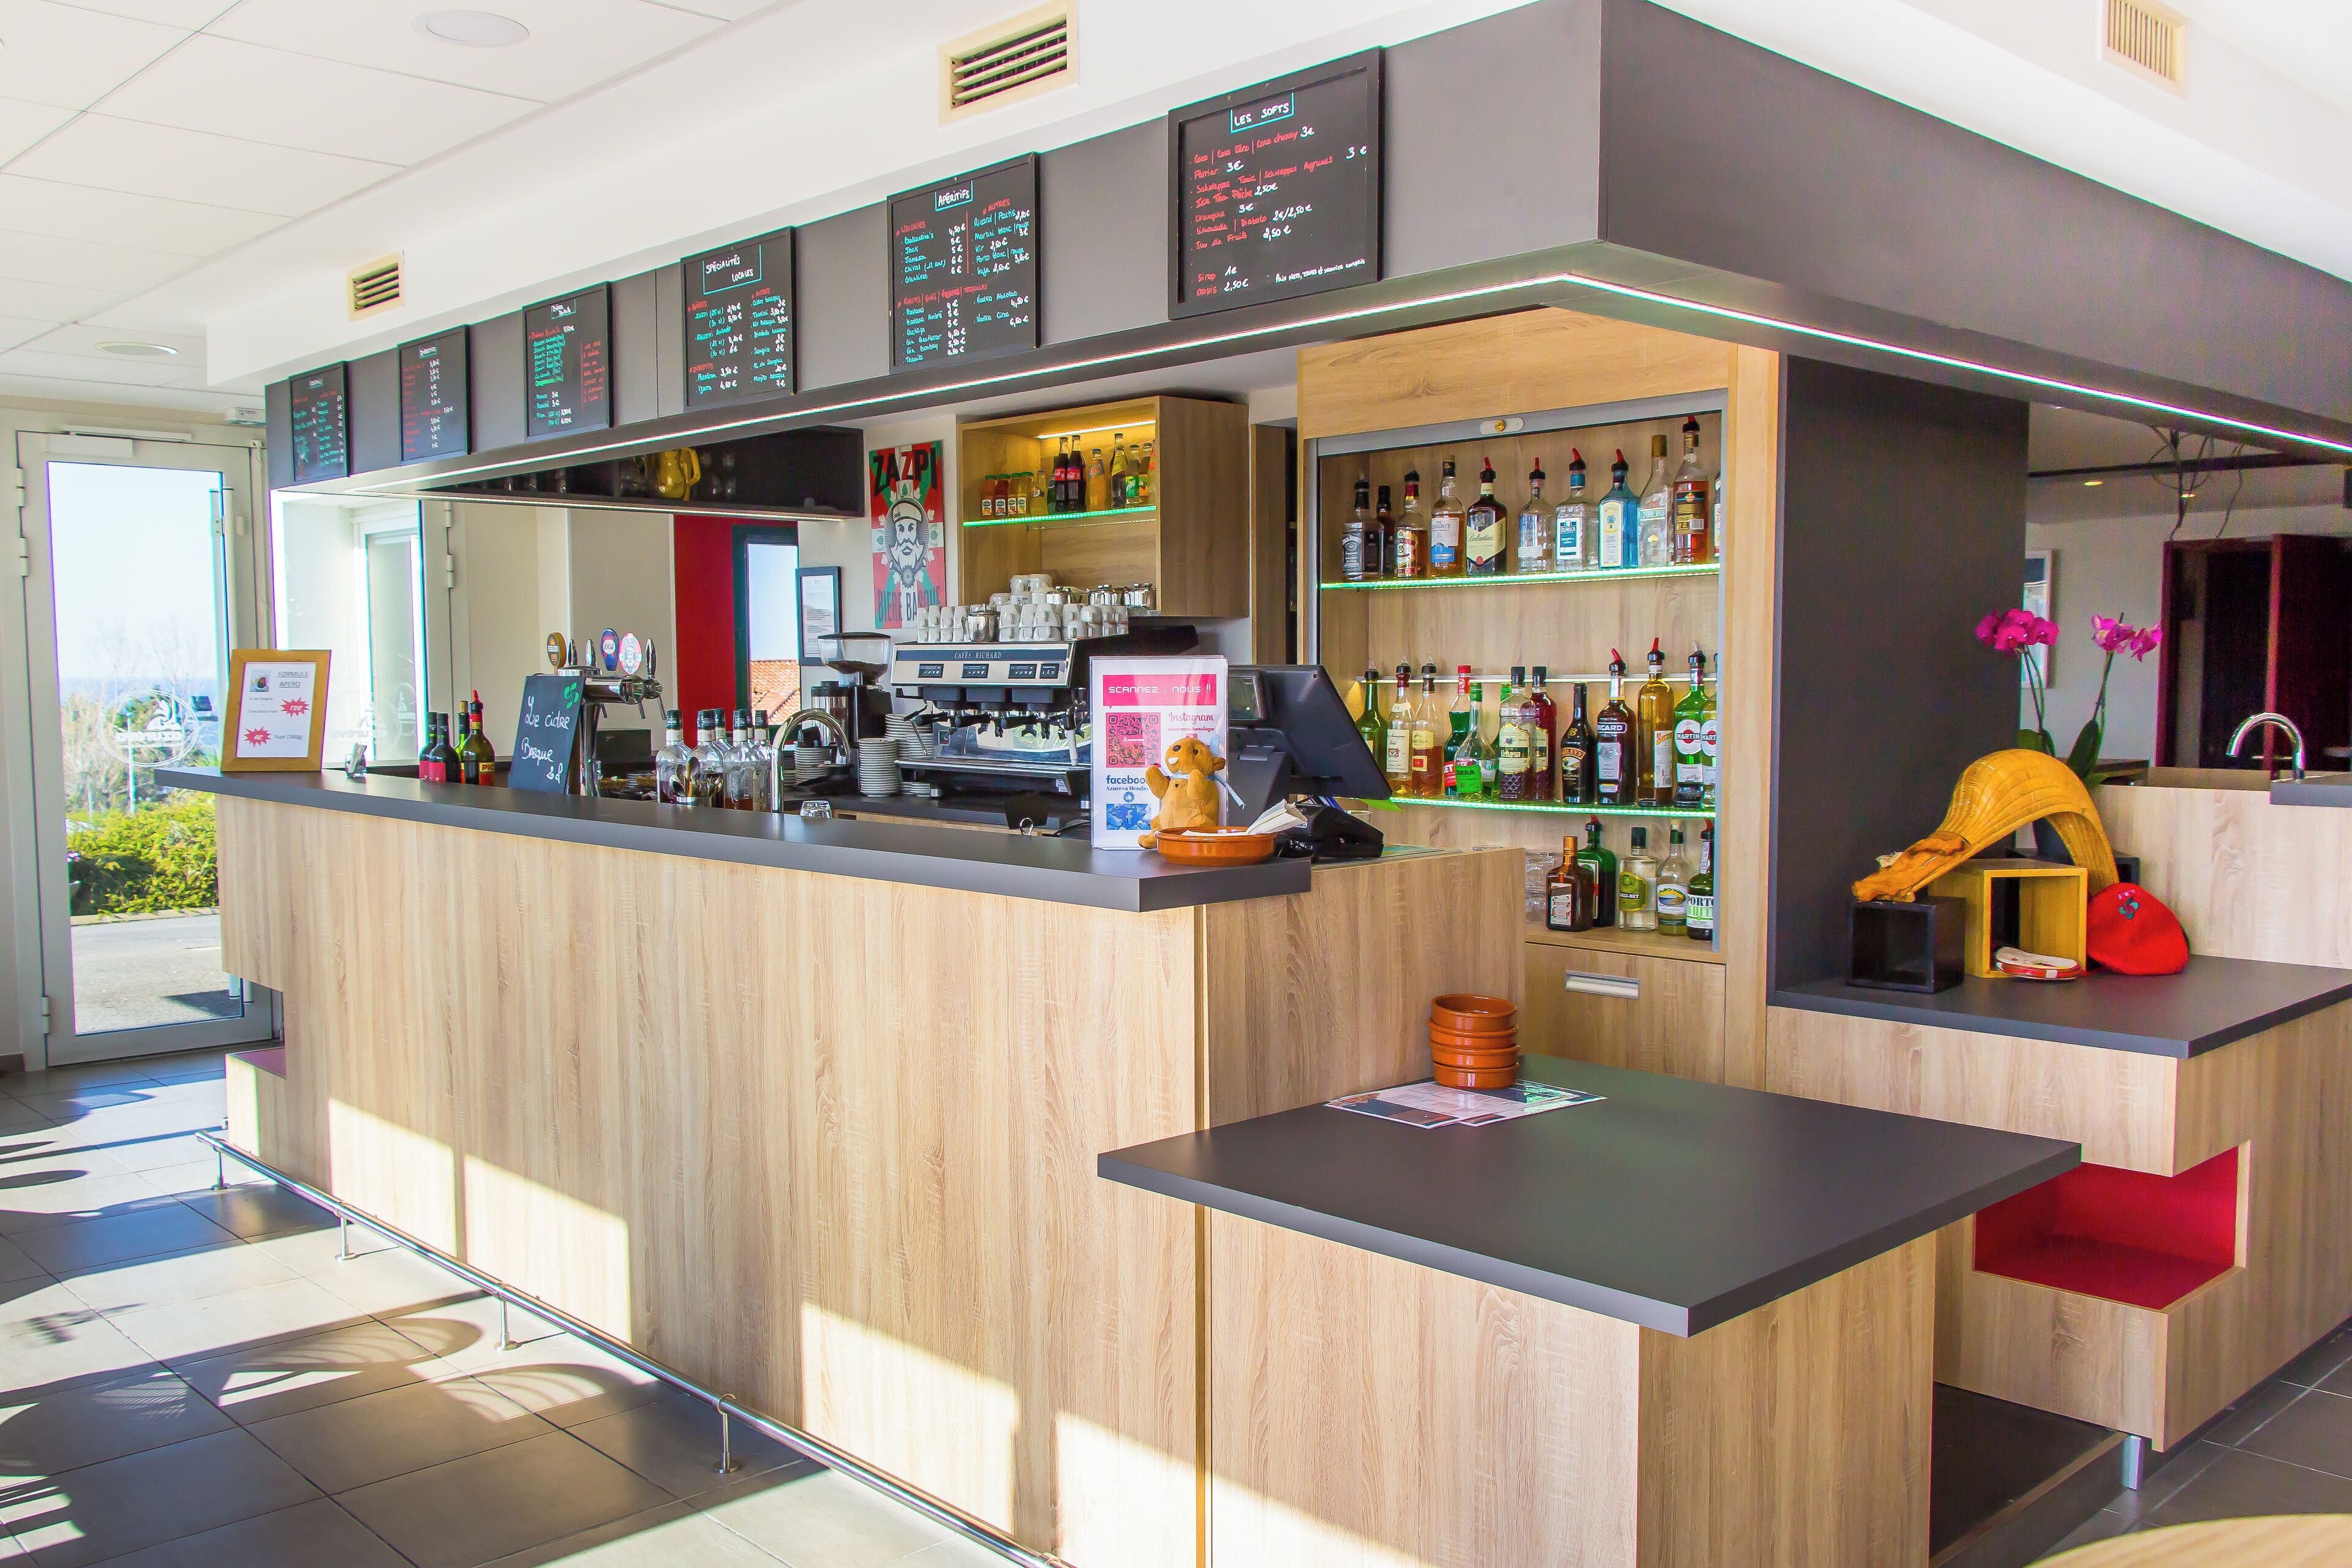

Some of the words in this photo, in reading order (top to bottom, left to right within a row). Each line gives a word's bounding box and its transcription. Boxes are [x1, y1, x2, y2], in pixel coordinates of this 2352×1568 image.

[1234, 113, 1253, 126] LES
[1261, 102, 1290, 119] SOFTS
[1300, 125, 1315, 138] 3€
[1226, 160, 1245, 173] 3€
[1238, 203, 1255, 214] 3€
[731, 268, 754, 282] LOCALES
[1223, 278, 1250, 293] 2,50€
[872, 447, 937, 498] ZAZPI
[1109, 685, 1159, 694] SCANNEZ
[1172, 685, 1201, 693] NOUS
[544, 710, 570, 731] cidre
[1168, 712, 1215, 726] Instagram
[521, 736, 554, 766] Basque
[1106, 775, 1147, 786] faceboo
